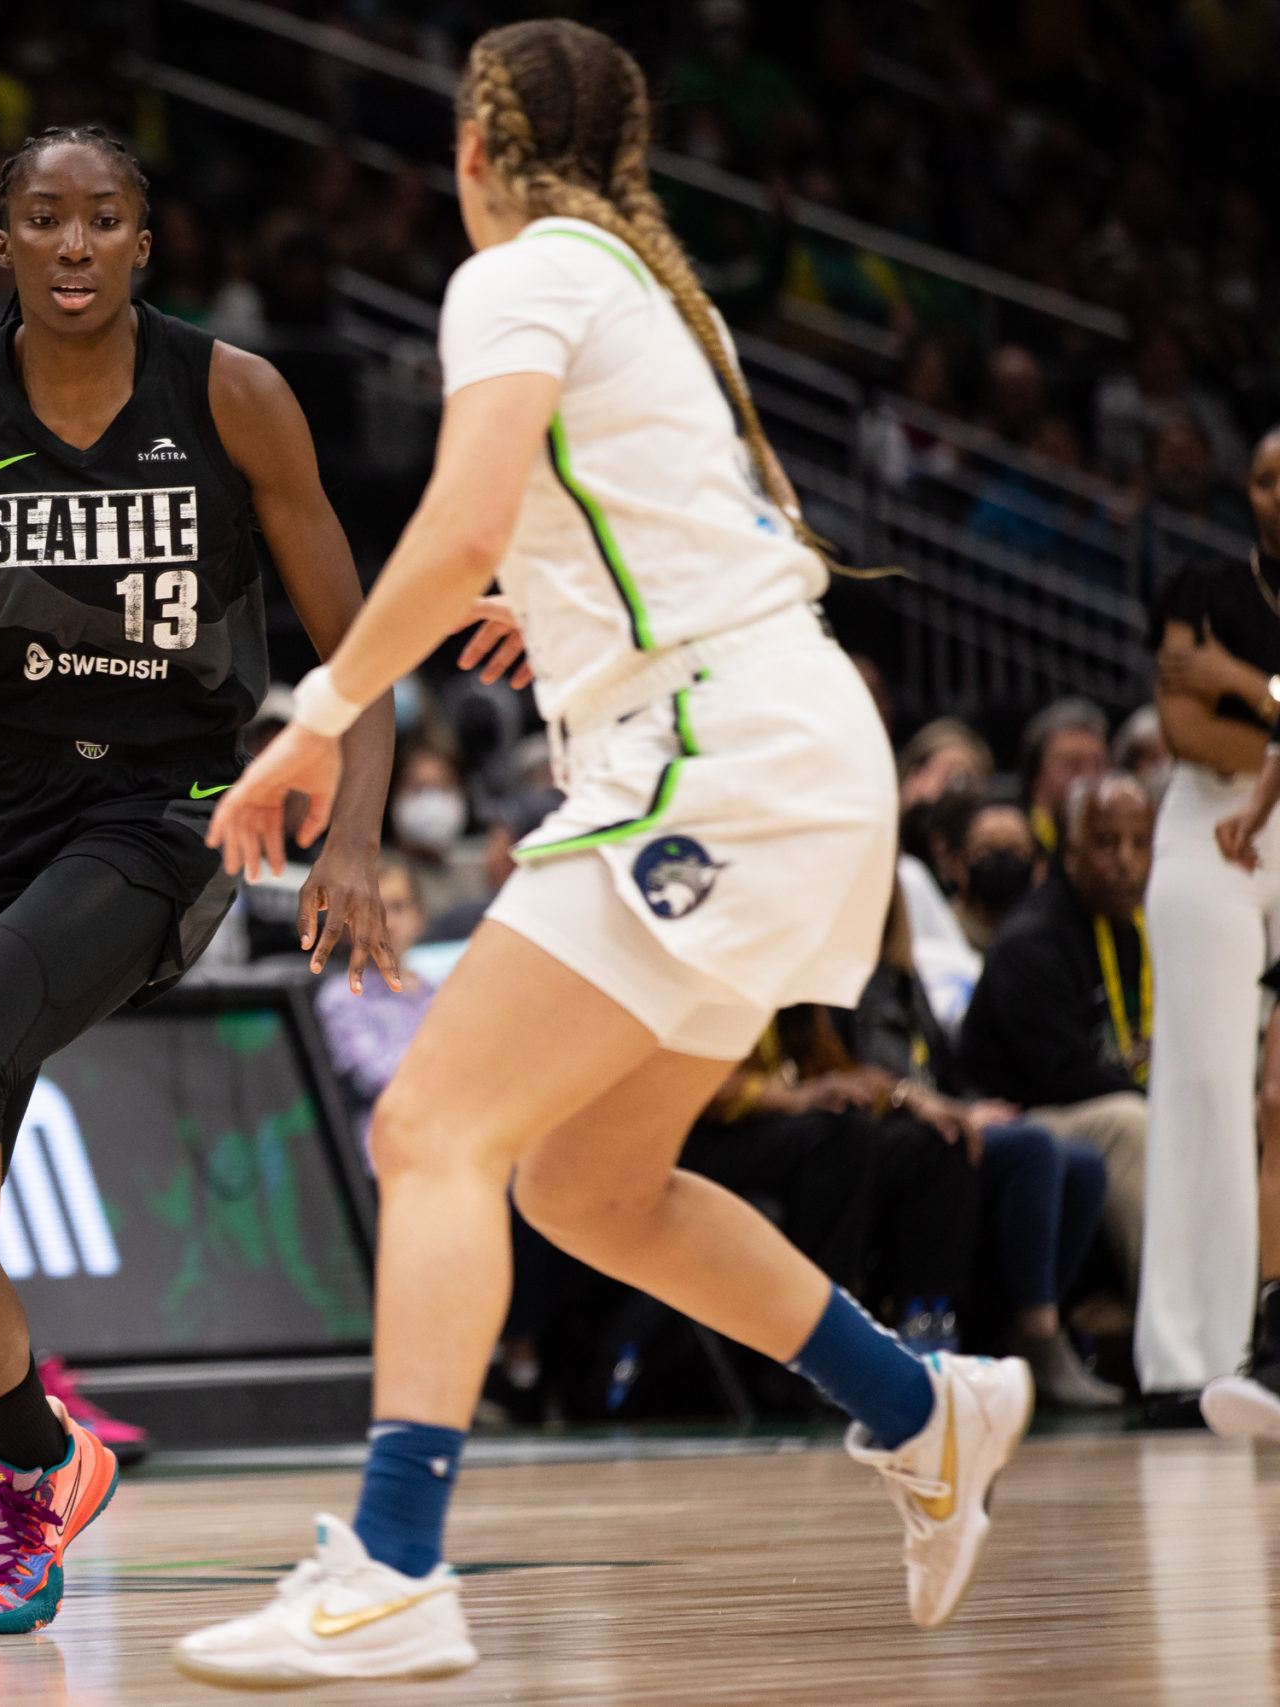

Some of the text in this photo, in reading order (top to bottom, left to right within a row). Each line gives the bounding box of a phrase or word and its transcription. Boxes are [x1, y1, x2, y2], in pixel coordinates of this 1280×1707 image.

[138, 452, 187, 461] SYMETRA
[116, 569, 198, 650] 13
[57, 653, 168, 680] SWEDISH
